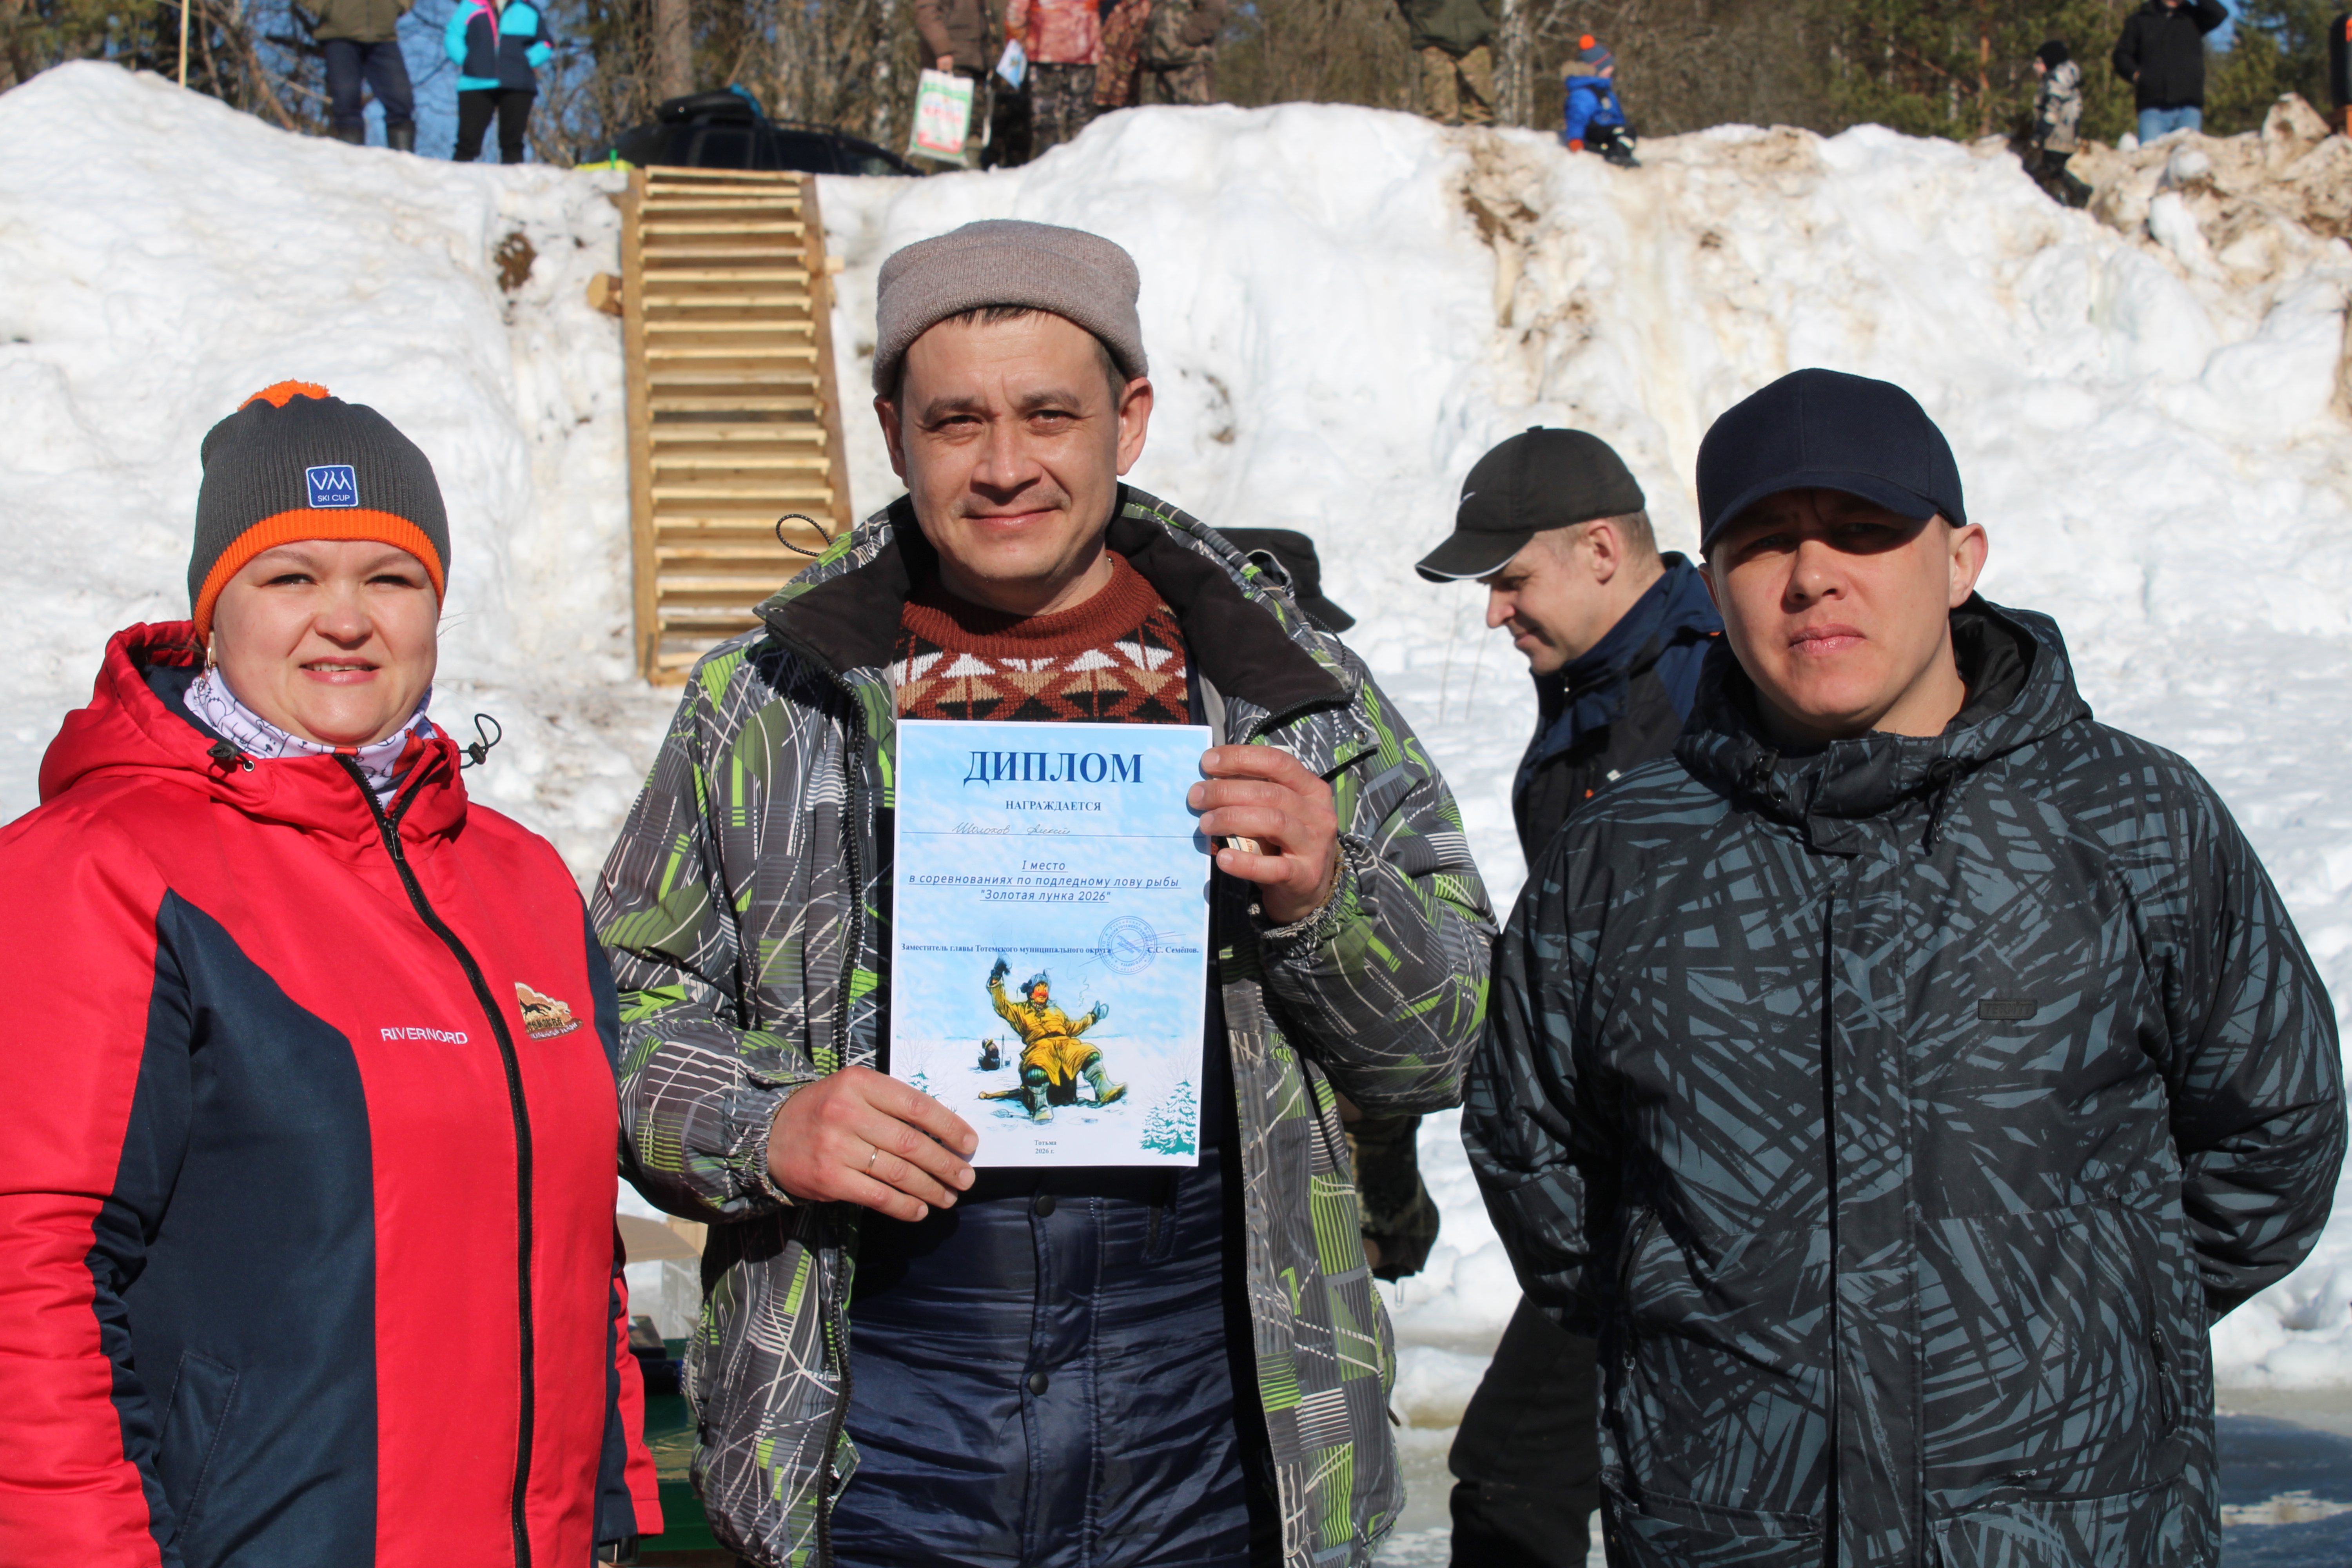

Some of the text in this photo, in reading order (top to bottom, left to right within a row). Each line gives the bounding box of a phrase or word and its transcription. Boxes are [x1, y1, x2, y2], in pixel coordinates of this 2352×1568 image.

[963, 751, 1145, 789] ДИПЛОМ
[1005, 800, 1102, 812] НАГРАЖДАЕТСЯ
[1030, 862, 1066, 870] место
[919, 875, 1014, 886] соревнованиях
[1016, 877, 1032, 885] по
[1035, 877, 1111, 888] подледному
[1113, 878, 1143, 889] лову
[1145, 876, 1179, 889] рыбы
[981, 889, 1112, 902] "Золотая лунка 2026"
[901, 943, 948, 952] Заместитель
[975, 945, 1018, 953] Тотемского
[1019, 946, 1084, 955] муниципального
[1085, 947, 1111, 956] округа
[380, 1027, 468, 1045] RIVERNORD
